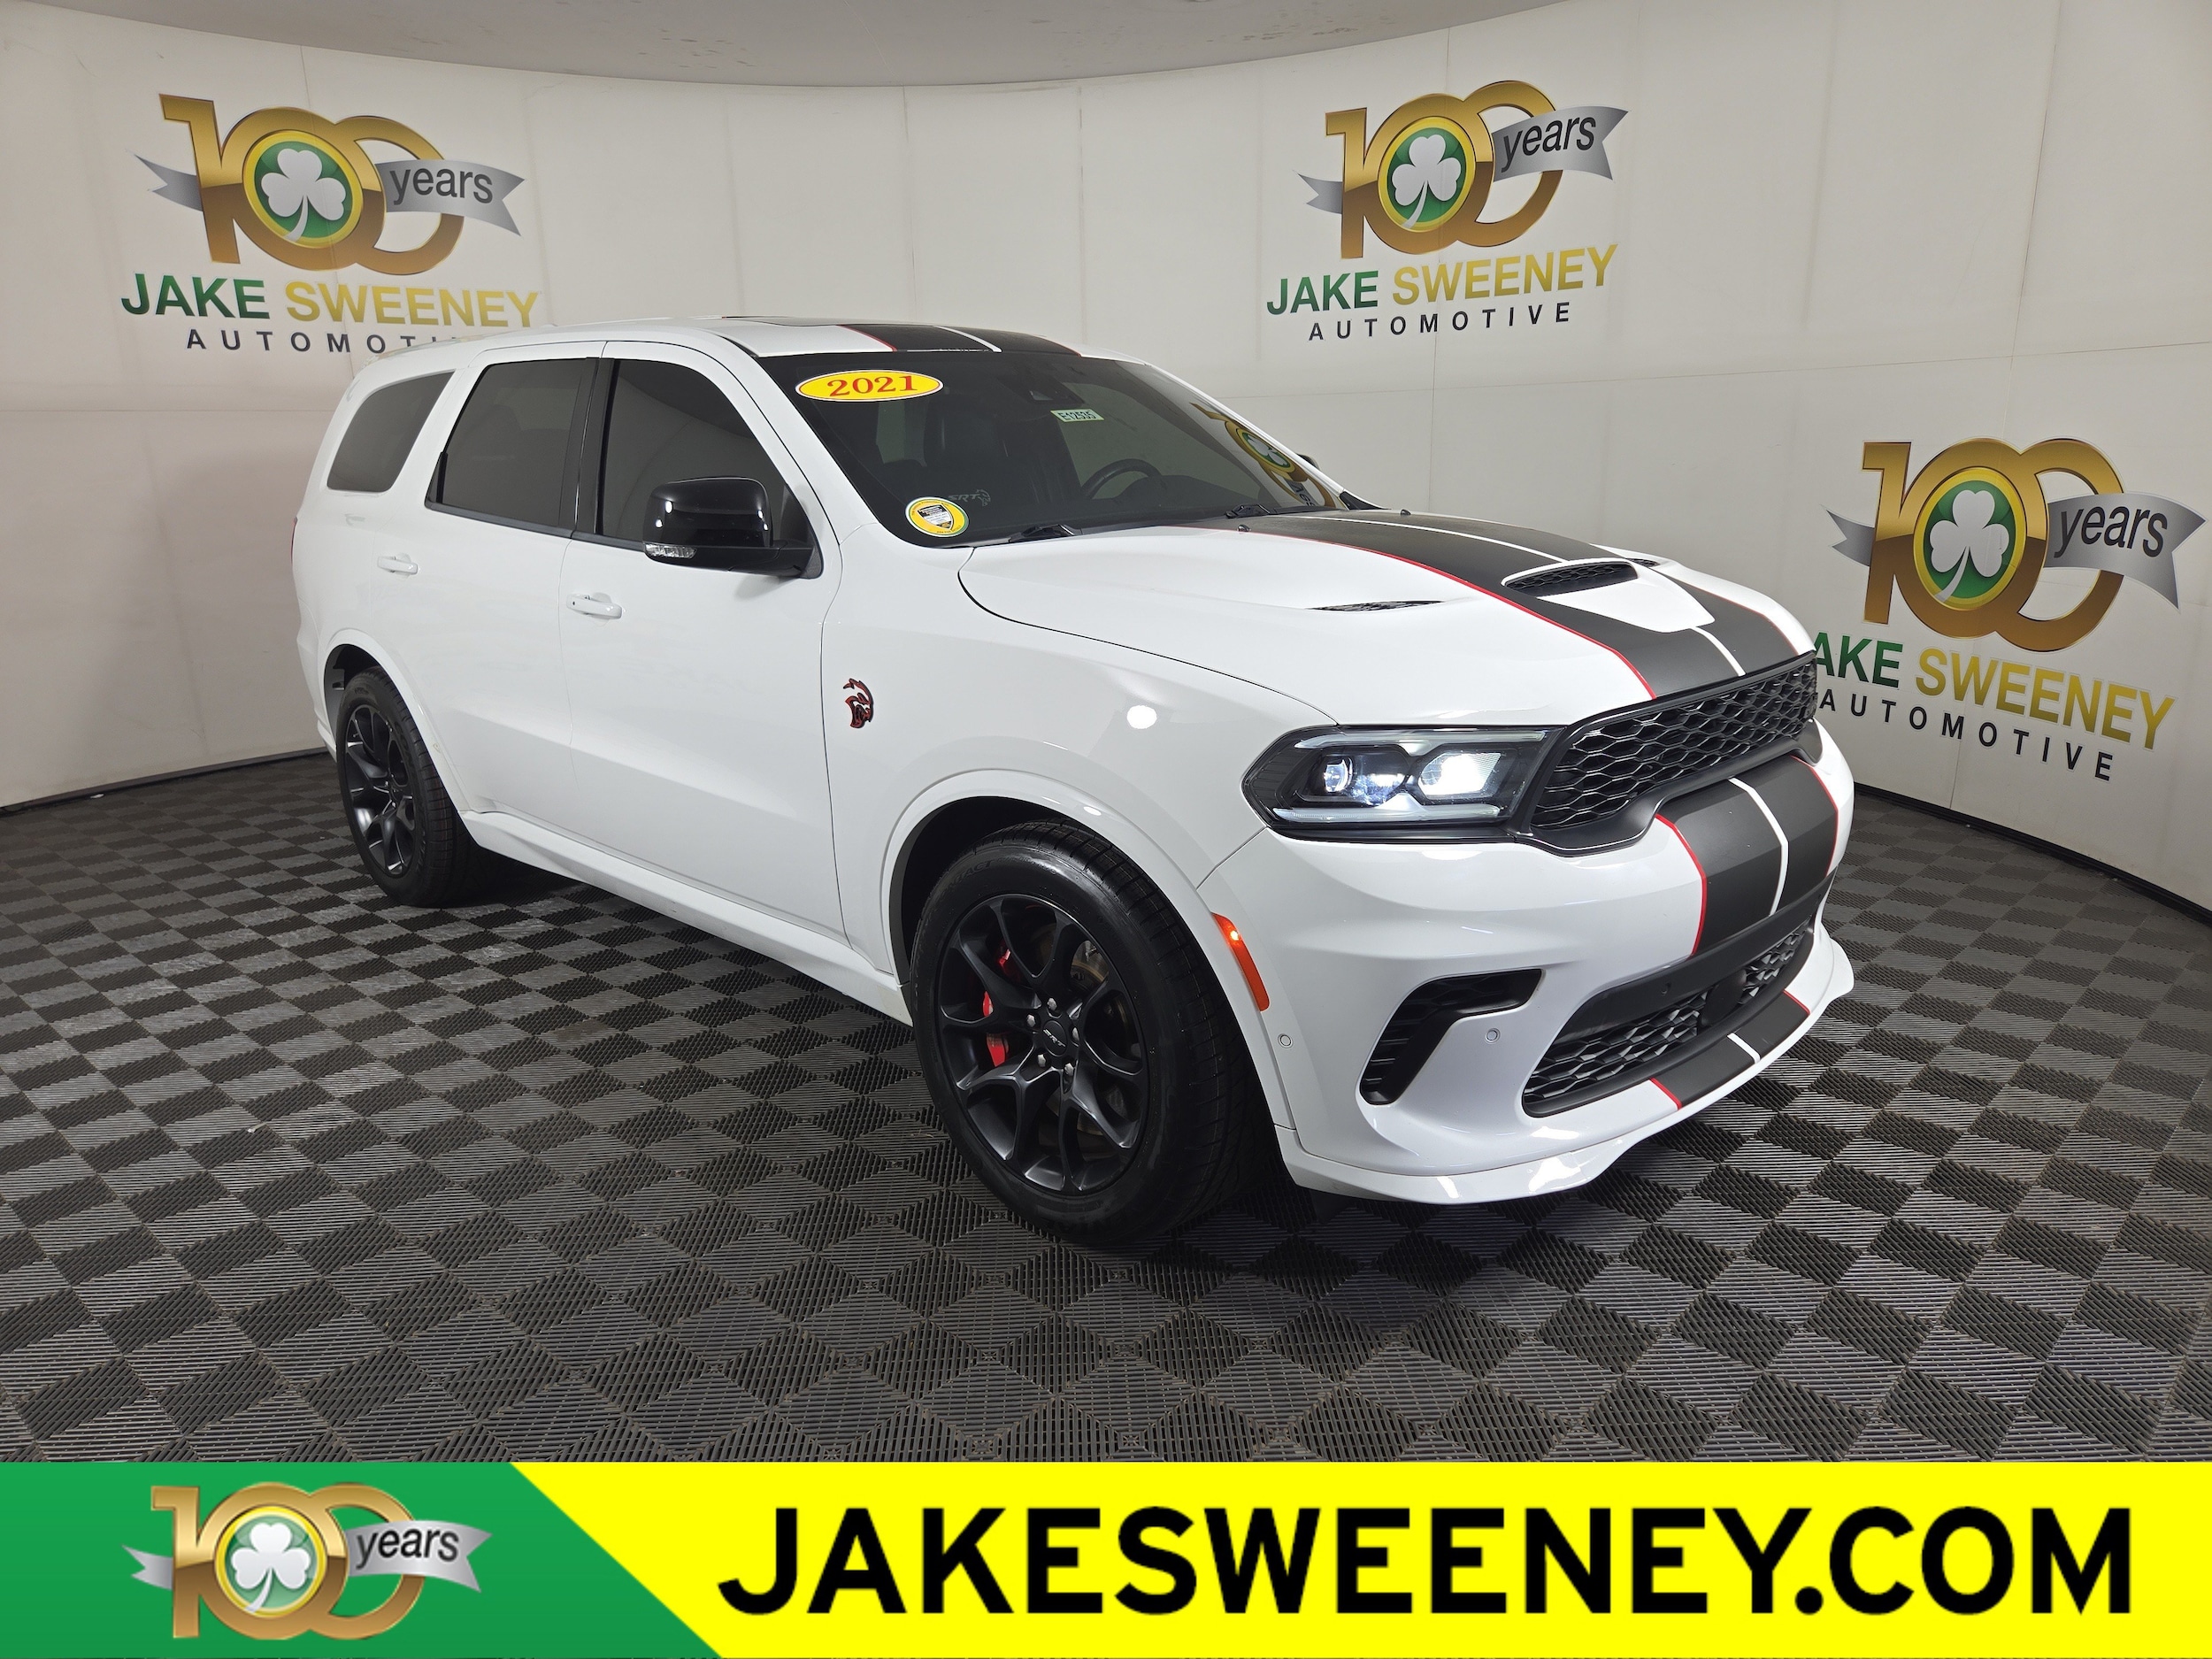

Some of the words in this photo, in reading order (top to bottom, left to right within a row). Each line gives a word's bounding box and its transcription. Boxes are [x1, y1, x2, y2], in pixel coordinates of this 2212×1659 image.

[1502, 115, 1596, 173] years
[389, 166, 494, 206] years
[121, 273, 270, 319] JAKE
[285, 280, 539, 327] SWEENEY
[1266, 270, 1379, 316] JAKE
[1393, 243, 1618, 306] SWEENEY
[186, 328, 456, 353] AUTOMOT
[1309, 302, 1570, 342] AUTOMOTIVE
[826, 375, 918, 396] 2021
[2054, 504, 2169, 557] years
[1814, 632, 1903, 688] AKE
[1916, 648, 2176, 749] SWEENEY
[1819, 688, 2113, 781] AUTOMOTIVE
